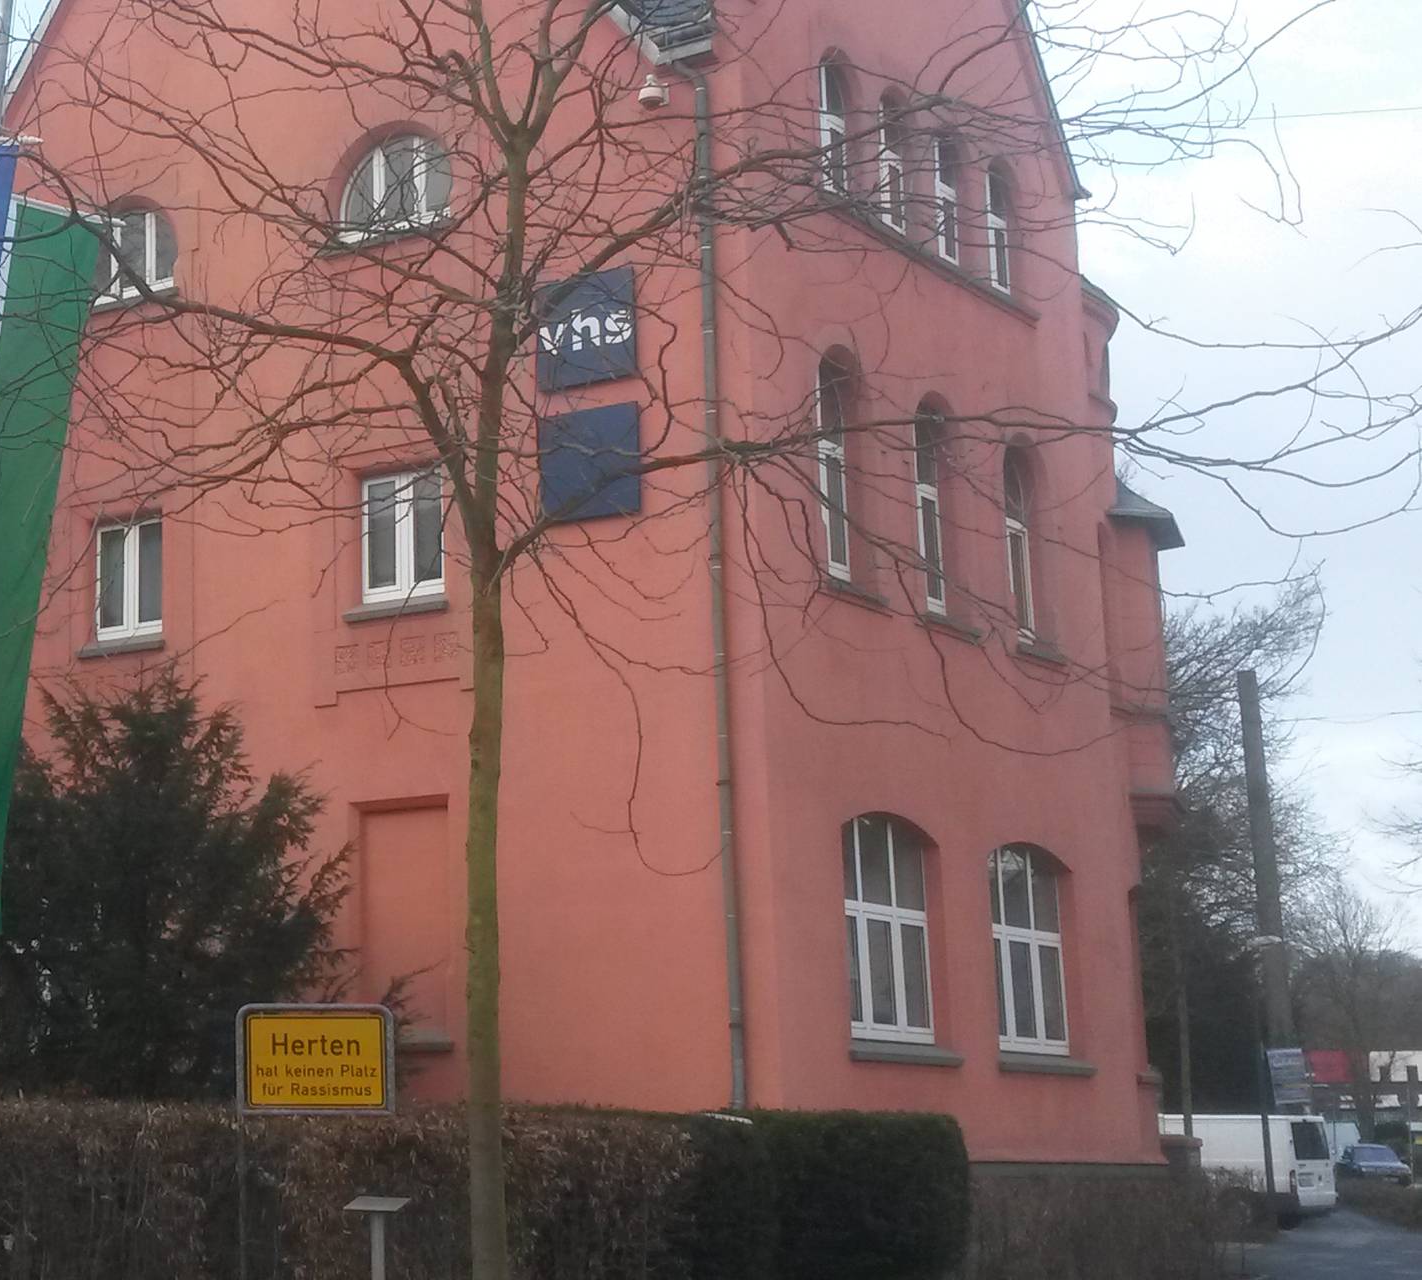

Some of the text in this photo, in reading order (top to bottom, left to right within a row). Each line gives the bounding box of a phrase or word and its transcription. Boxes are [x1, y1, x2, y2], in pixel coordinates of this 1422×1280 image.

[539, 309, 632, 355] vhs
[271, 1032, 361, 1056] Herten
[256, 1064, 377, 1078] hat keinen Platz
[262, 1083, 372, 1097] für Rassismus
